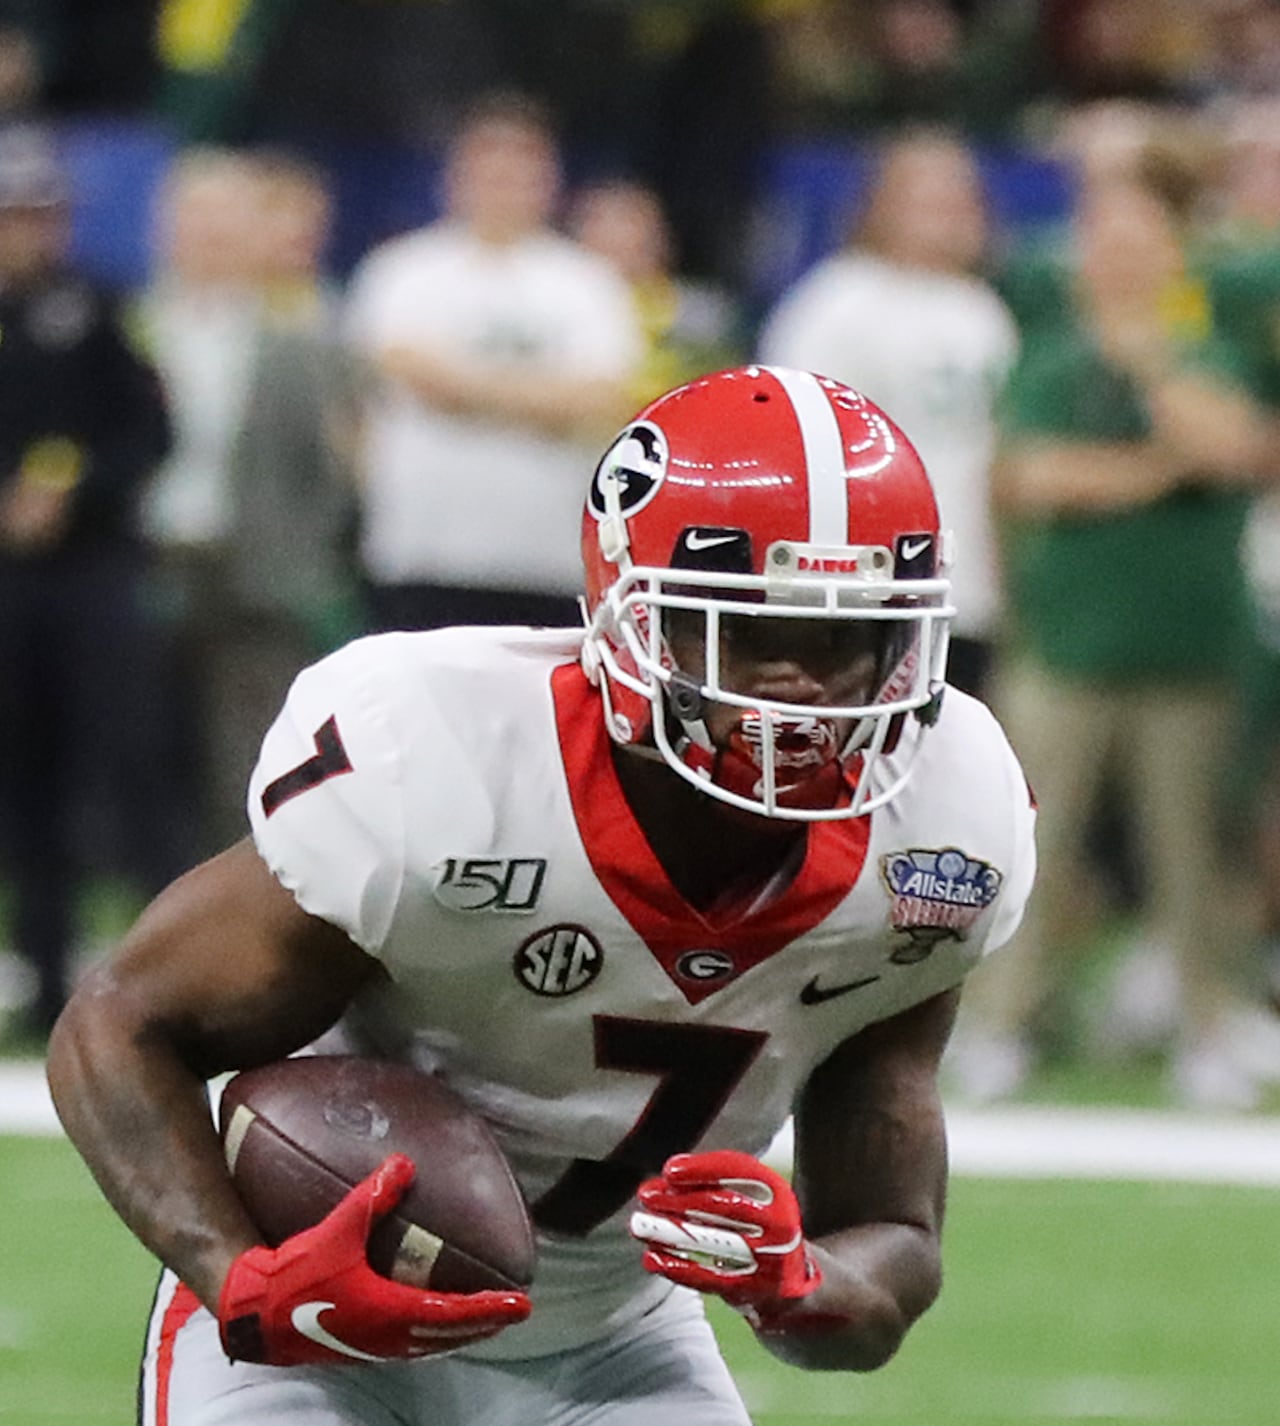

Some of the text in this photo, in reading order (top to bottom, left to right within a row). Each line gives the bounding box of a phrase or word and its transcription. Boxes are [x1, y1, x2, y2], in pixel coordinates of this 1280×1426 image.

[441, 858, 547, 910] 150
[902, 870, 983, 905] Allstate
[515, 925, 603, 996] SEC
[681, 950, 734, 980] G
[530, 1013, 773, 1240] 7
